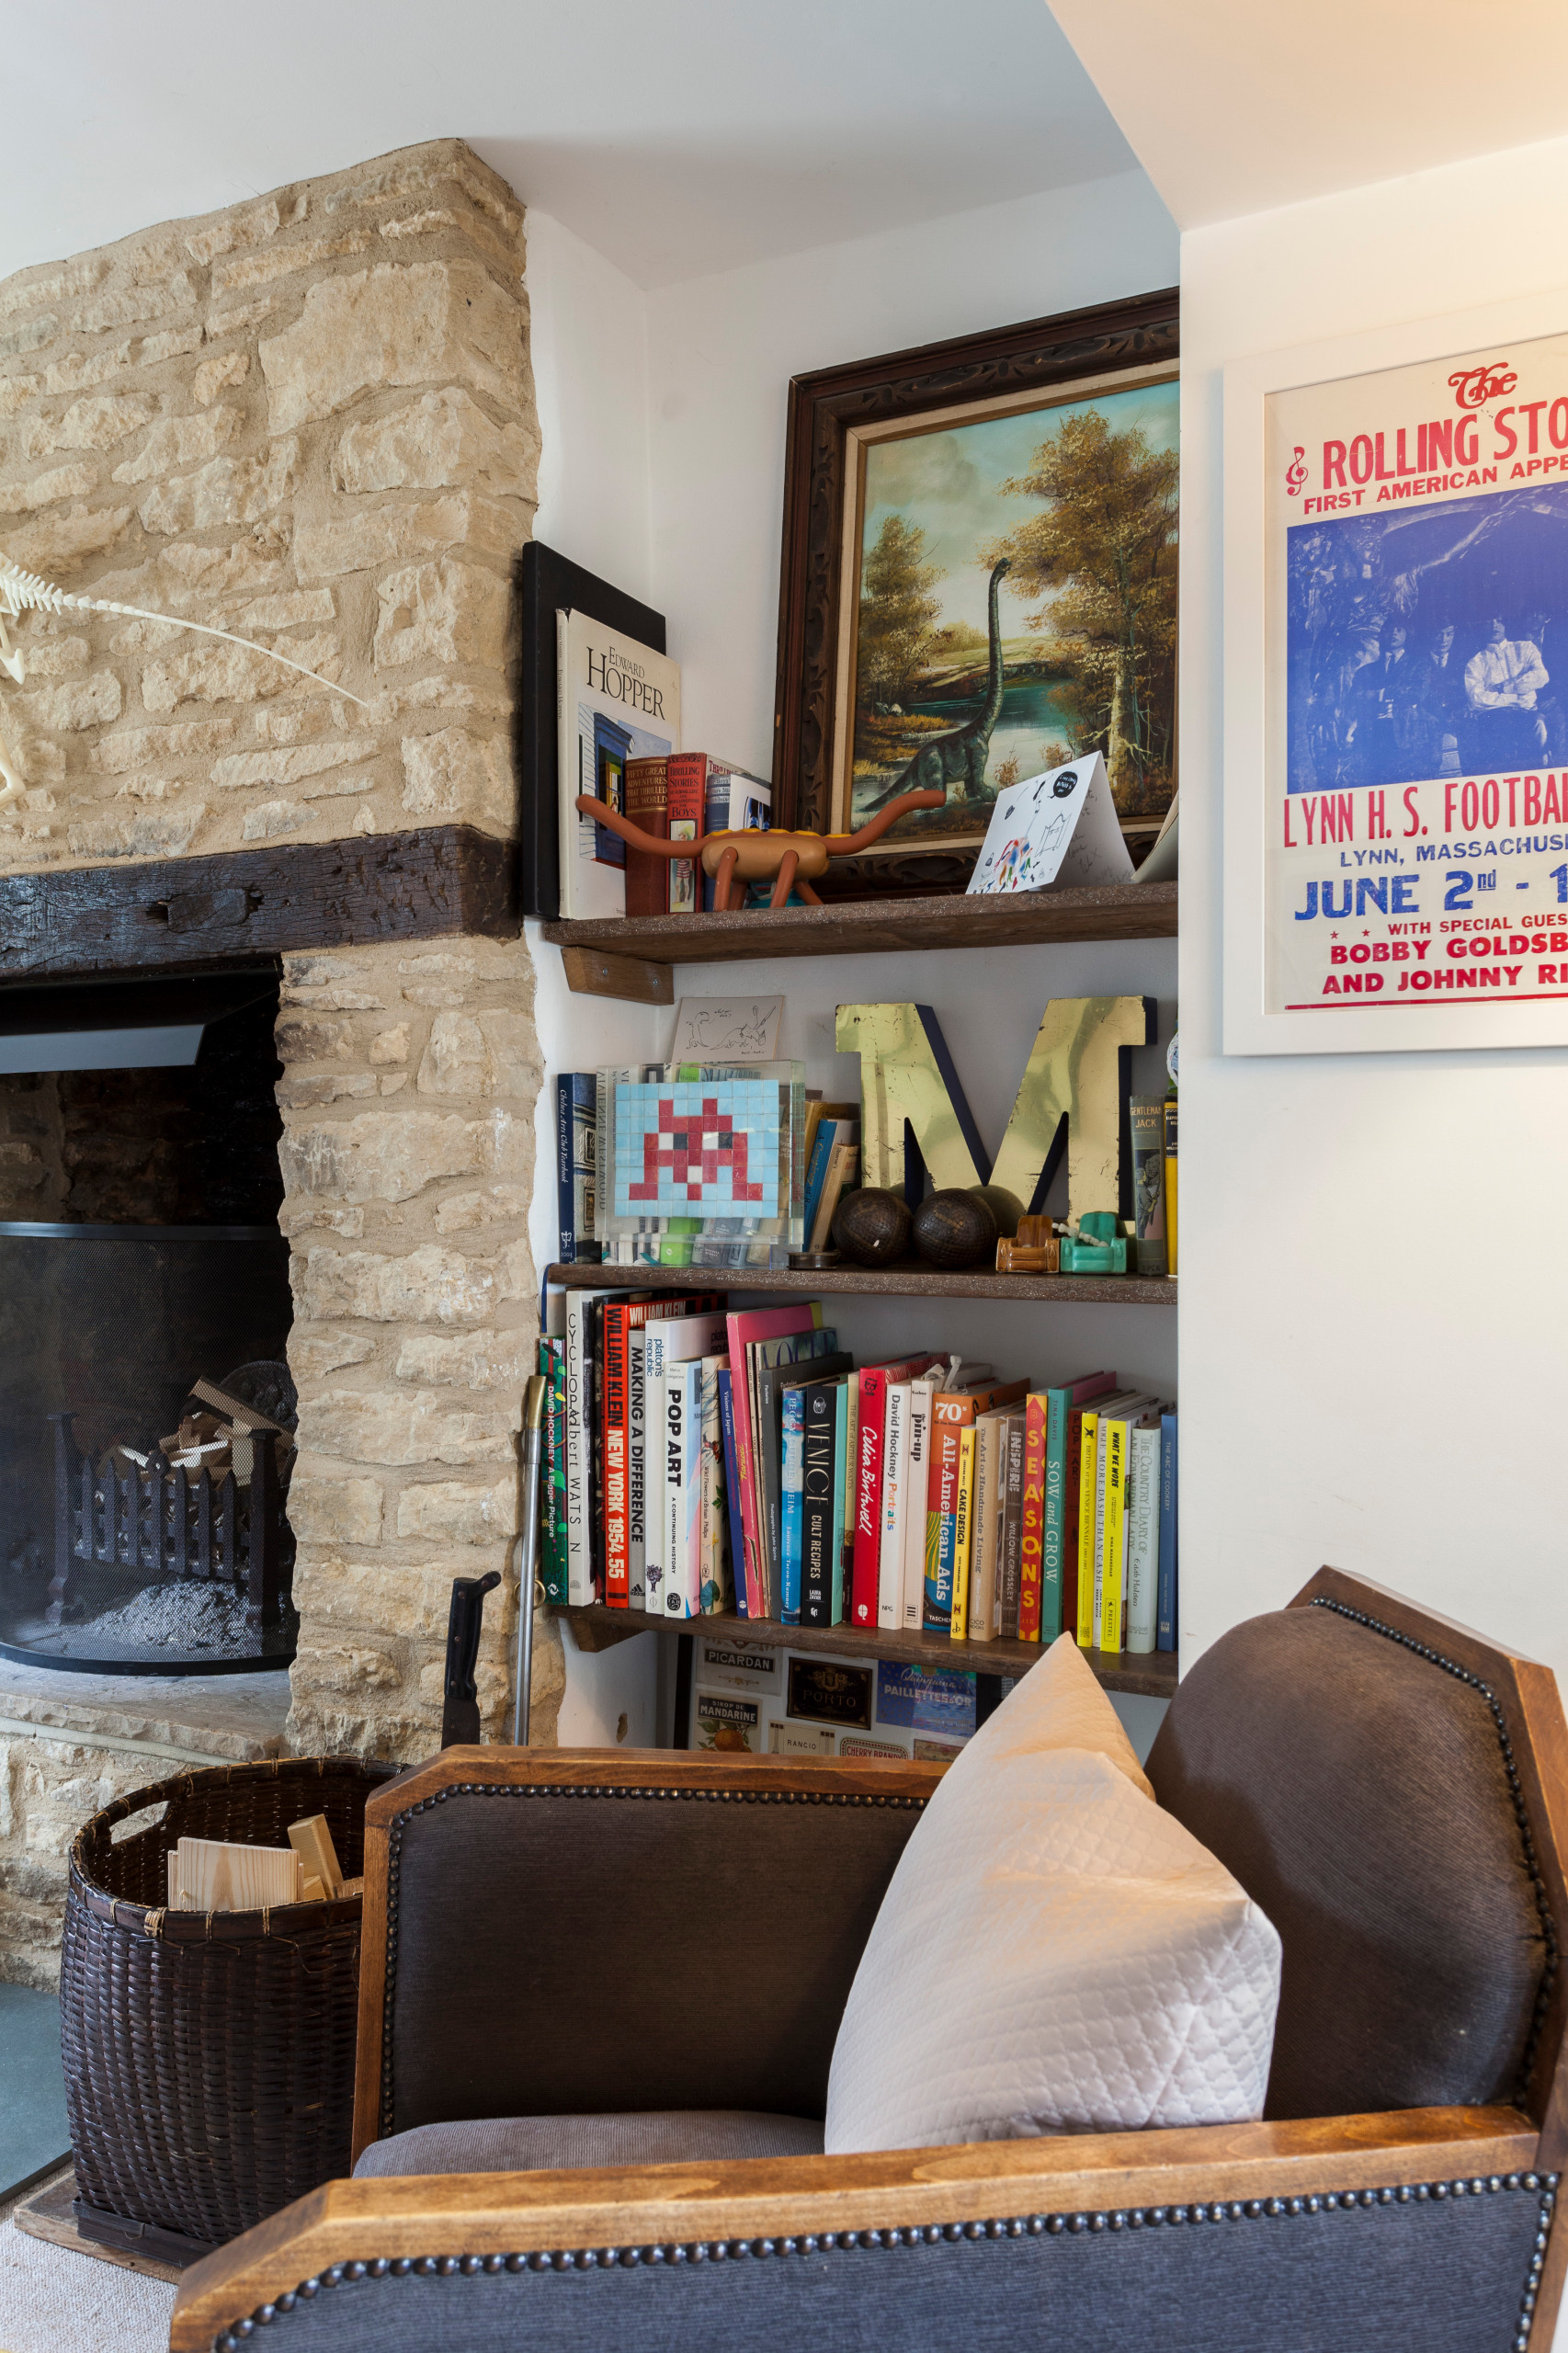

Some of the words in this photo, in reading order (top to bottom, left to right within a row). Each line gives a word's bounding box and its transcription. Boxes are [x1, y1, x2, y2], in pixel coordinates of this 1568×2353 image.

[1448, 362, 1517, 409] The
[1323, 414, 1479, 490] ROLLING
[1494, 397, 1568, 460] STO
[1303, 489, 1367, 515] FIRST
[1376, 467, 1497, 502] AMERICAN
[608, 645, 645, 678] EDWARD
[586, 646, 665, 721] HOPPER
[627, 768, 643, 779] FIFTY
[645, 767, 666, 775] GREAT
[627, 777, 667, 788] ADVENTURES
[669, 767, 700, 776] THRILLING
[669, 778, 699, 788] STORIES
[627, 789, 640, 797] THAT
[640, 786, 667, 796] THRILLED
[627, 798, 639, 806] THE
[641, 795, 667, 804] WORLD
[672, 807, 697, 817] BOYS
[1284, 793, 1353, 847] LYNN
[1369, 790, 1392, 839] H.
[1403, 786, 1428, 837] S.
[1340, 849, 1404, 867] LYNN,
[1416, 835, 1568, 862] MASSACHUS
[1294, 874, 1420, 921] JUNE
[1444, 870, 1496, 911] 2nd
[1388, 923, 1431, 936] WITH
[1439, 917, 1512, 933] SPECIAL
[1521, 914, 1568, 928] GUES
[1330, 940, 1431, 965] BOBBY
[1447, 932, 1568, 959] GOLDSB
[1322, 972, 1384, 995] AND
[1397, 965, 1523, 992] JOHNNY
[560, 1089, 568, 1115] Chelsea
[835, 995, 1156, 1241] M
[1131, 1107, 1162, 1115] GENTLEMAN
[560, 1115, 568, 1133] Arts
[1135, 1119, 1156, 1128] JACK
[560, 1134, 568, 1152] Club
[561, 1152, 569, 1184] Yearbook
[629, 1304, 664, 1326] WILLIAM
[664, 1301, 687, 1318] KLEIN
[607, 1307, 622, 1378] WILLIAM
[645, 1338, 654, 1377] republic
[653, 1338, 665, 1377] platon's
[547, 1385, 555, 1414] DAVID
[631, 1347, 643, 1420] MAKING
[608, 1381, 623, 1427] KLEIN
[668, 1389, 681, 1437] POP
[788, 1397, 797, 1433] PEGGY
[891, 1394, 901, 1427] David
[547, 1415, 555, 1461] HOCKNEY
[608, 1429, 624, 1469] NEW
[631, 1426, 643, 1439] A
[861, 1426, 878, 1467] Celia
[911, 1414, 926, 1462] pin-up
[1111, 1431, 1119, 1453] WHAT
[1141, 1435, 1153, 1453] THE
[668, 1439, 681, 1487] ART
[805, 1423, 831, 1506] VENICE
[888, 1429, 900, 1480] Hockney
[1009, 1431, 1022, 1492] INSPIRE
[1111, 1454, 1119, 1466] WE
[547, 1475, 556, 1505] Bigger
[608, 1471, 624, 1513] YORK
[787, 1438, 797, 1515] GUGGENHEIM
[1047, 1461, 1061, 1498] SOW
[1110, 1467, 1119, 1488] WORE
[1139, 1455, 1153, 1505] COUNTRY
[631, 1445, 643, 1542] DIFFERENCE
[859, 1468, 877, 1537] Birtwell
[886, 1483, 898, 1530] Portraits
[937, 1434, 957, 1559] All-American
[958, 1488, 968, 1513] CAKE
[977, 1475, 986, 1534] Handmade
[548, 1506, 556, 1538] Picture
[811, 1515, 823, 1538] CULT
[957, 1514, 966, 1545] DESIGN
[1021, 1428, 1040, 1608] SEASONS
[1046, 1501, 1059, 1526] and
[1138, 1506, 1152, 1540] DIARY
[607, 1517, 624, 1579] 1954.55
[974, 1536, 983, 1574] Living
[1008, 1521, 1017, 1556] WILLOW
[1138, 1541, 1148, 1554] OF
[810, 1540, 822, 1579] RECIPES
[1045, 1530, 1059, 1584] GROW
[1132, 1558, 1141, 1578] Edith
[936, 1564, 950, 1601] Ads
[1006, 1558, 1016, 1602] CROSSLEY
[1131, 1580, 1140, 1607] Holden
[929, 1615, 951, 1623] TASCHEN
[709, 1651, 770, 1670] PICARDAN
[699, 1705, 756, 1722] MANDARINE
[712, 1700, 734, 1709] SIROP
[802, 1689, 857, 1708] PORTO
[787, 1739, 817, 1750] RANCIO
[846, 1745, 873, 1757] CHERRY
